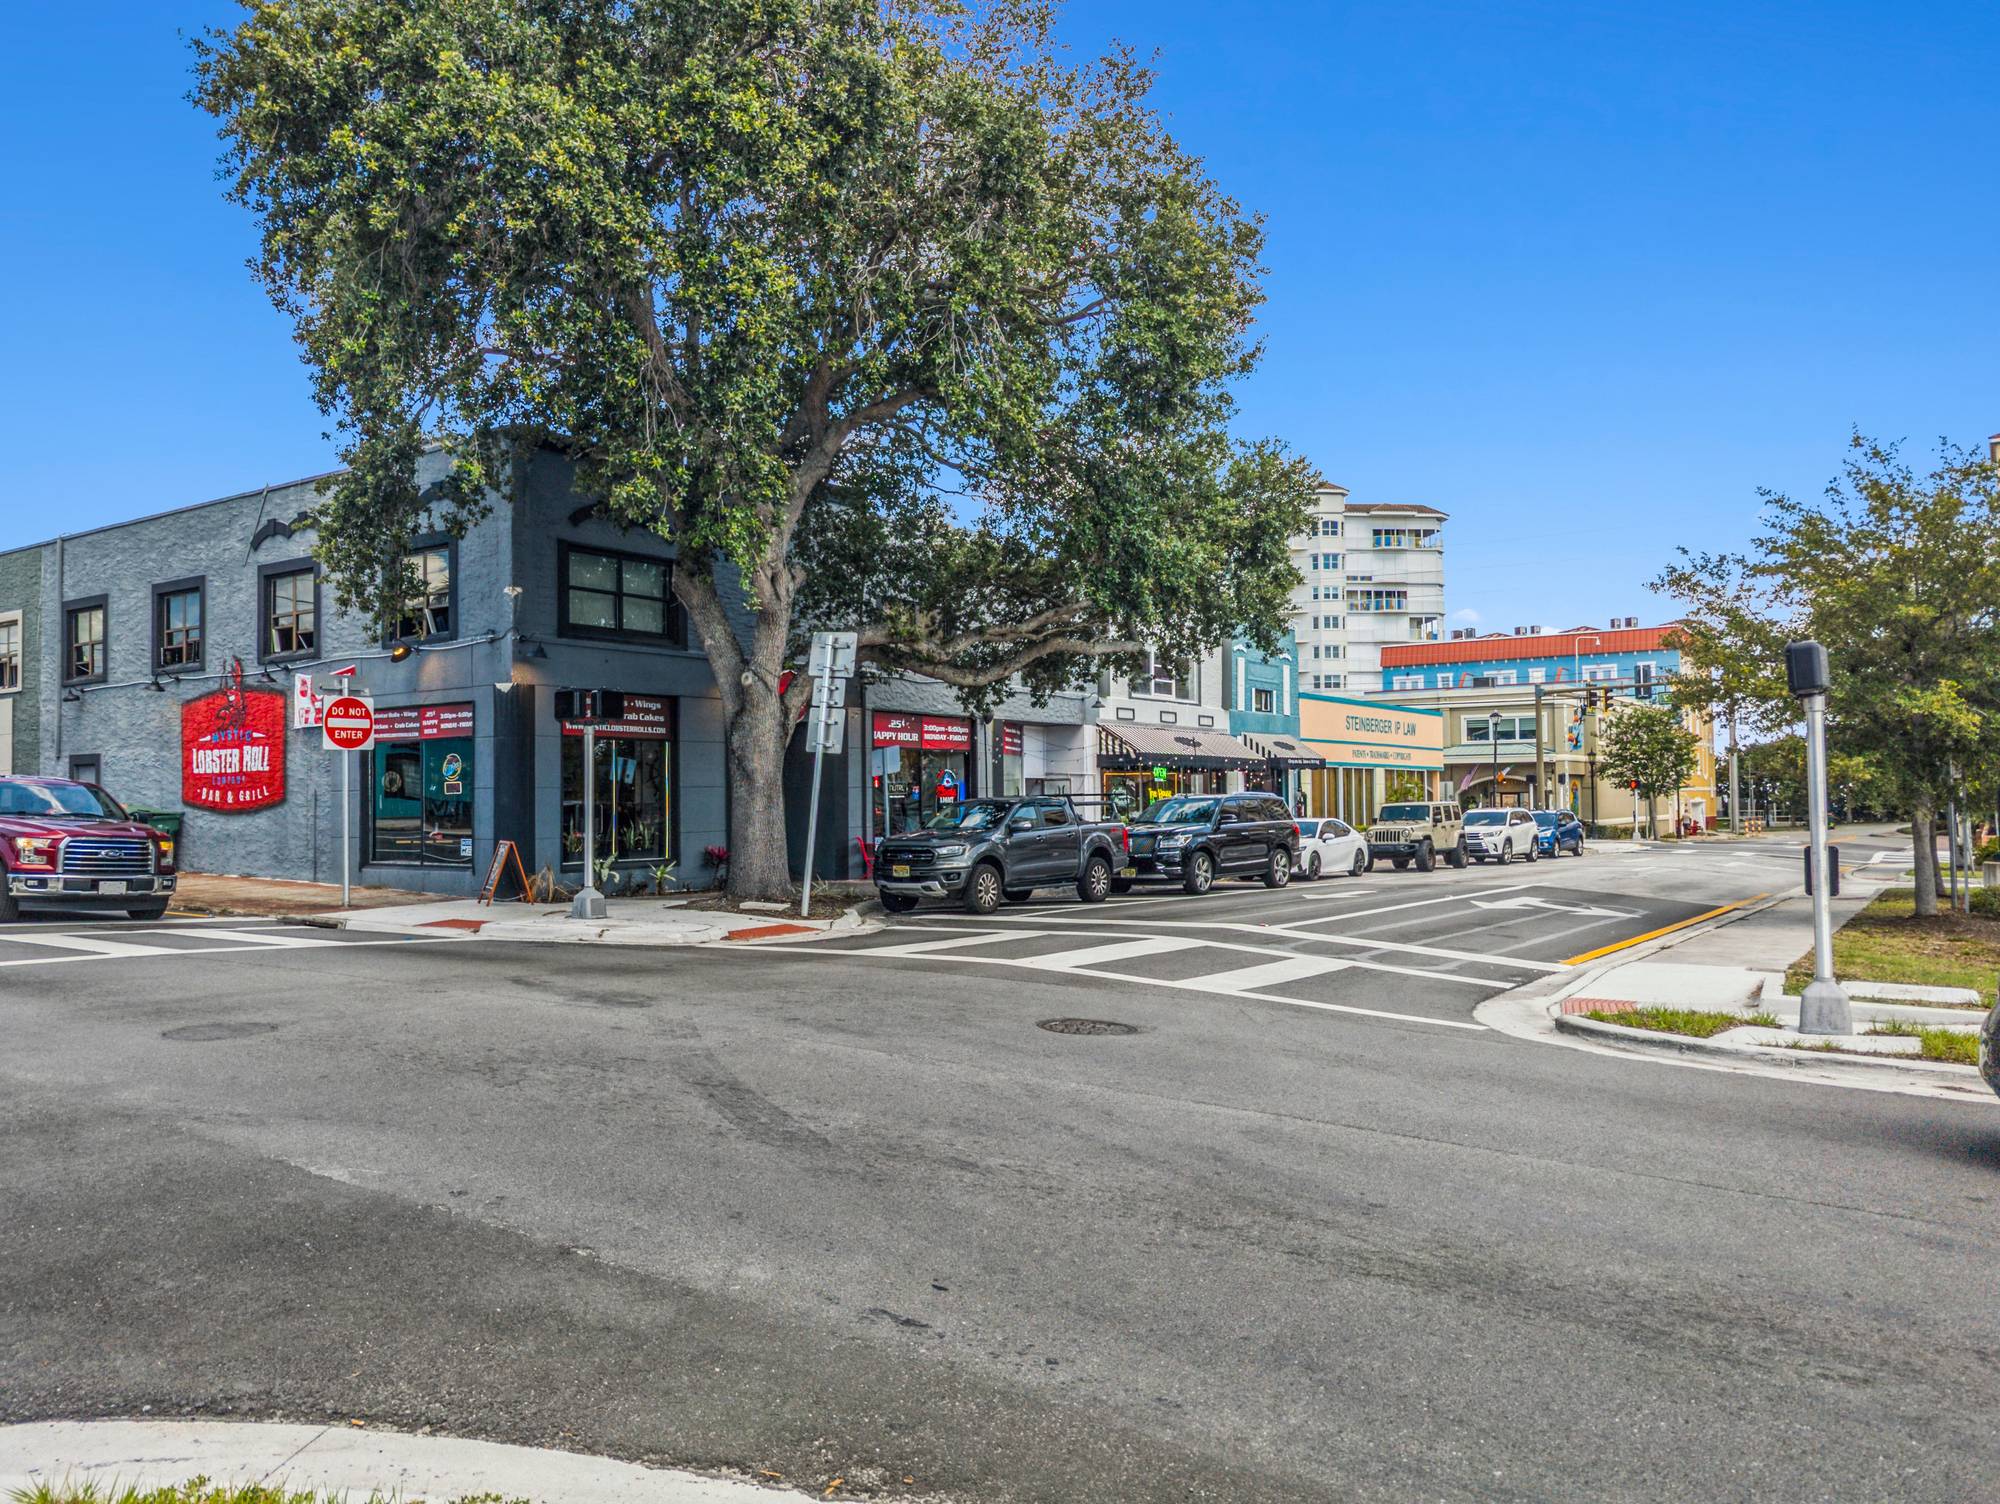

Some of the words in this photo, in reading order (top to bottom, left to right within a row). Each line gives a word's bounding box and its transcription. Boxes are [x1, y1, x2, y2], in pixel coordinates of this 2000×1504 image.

[635, 700, 661, 710] Wings
[332, 707, 344, 716] DO
[349, 707, 366, 717] NOT
[640, 714, 664, 722] Cakes
[1346, 715, 1392, 734] STEINBERGER
[1395, 721, 1401, 735] IP
[1403, 722, 1417, 736] LAW
[334, 730, 363, 739] ENTER
[898, 733, 919, 741] HOUR
[924, 733, 946, 741] MONDAY
[193, 748, 240, 774] LOBSTER
[243, 745, 270, 772] ROLL
[1153, 767, 1167, 779] OPEN
[227, 790, 233, 803] &
[239, 786, 269, 802] GRILL
